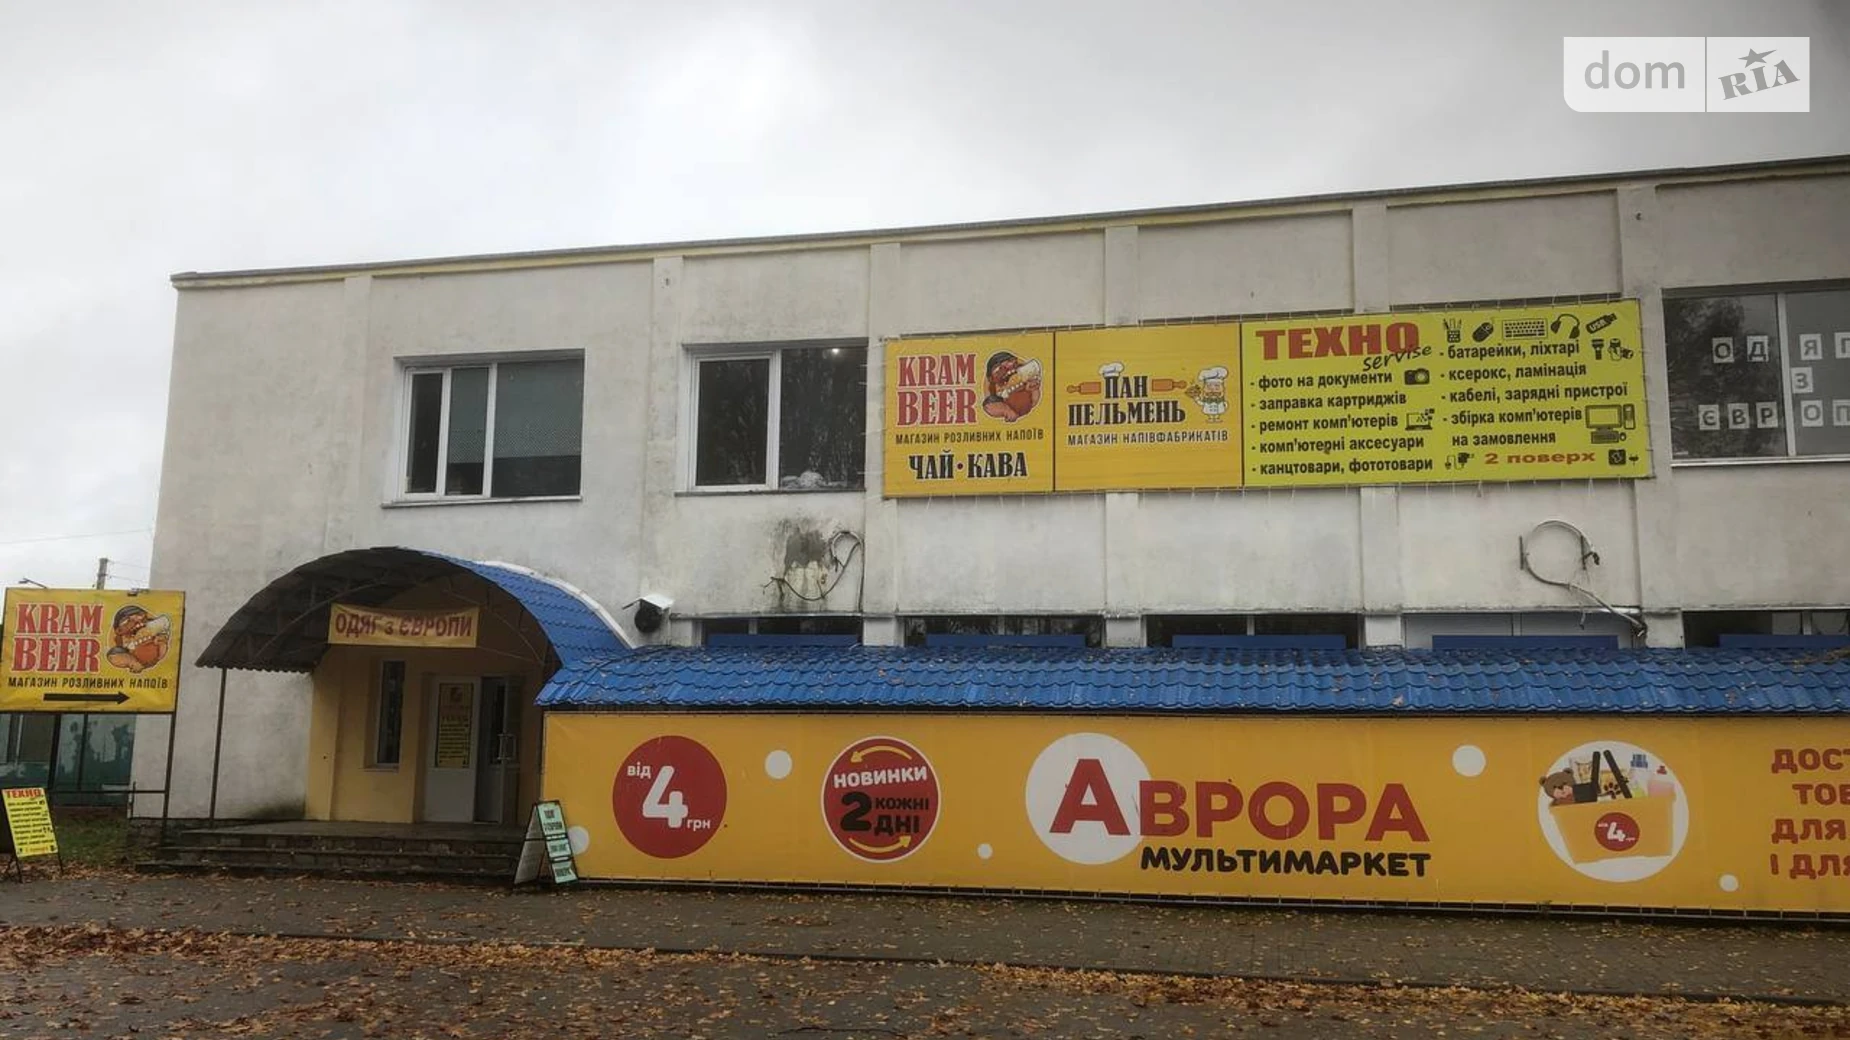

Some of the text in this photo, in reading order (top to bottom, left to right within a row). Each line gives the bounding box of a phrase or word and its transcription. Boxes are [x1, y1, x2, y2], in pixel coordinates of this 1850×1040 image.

[1256, 322, 1419, 360] ТЕХНО
[1448, 340, 1579, 361] батарейки, ліхтарі
[1363, 345, 1432, 372] servise
[897, 354, 976, 386] KRAM
[1449, 362, 1587, 382] ксерокс, ламінація
[1104, 376, 1148, 400] ПАН
[1258, 372, 1392, 392] фото на документи
[1450, 382, 1628, 404] кабелі, зарядні пристрої
[897, 387, 977, 427] BEER
[1259, 391, 1407, 412] заправка картриджів
[1068, 401, 1186, 427] ПЕЛЬМЕНЬ
[1259, 413, 1398, 434] ремонт комп'ютерів
[1451, 407, 1582, 426] збірка комп'ютерів
[896, 427, 1044, 445] МАГАЗИН РОЗЛИВНИХ НАПОЇВ
[1068, 430, 1228, 446] МАГАЗИН НАПІВФАБРИКАТІВ
[1349, 437, 1424, 452] аксесуари
[1452, 432, 1556, 446] на замовлення
[909, 449, 1028, 480] ЧАЙ КАВА
[1260, 458, 1433, 476] канцтовари, фототовари
[1484, 452, 1596, 465] 2 поверх
[15, 602, 104, 635] KRAM
[335, 612, 377, 638] ОДЯГ
[399, 616, 472, 638] ЄВРОПИ
[12, 636, 101, 673] BEER
[8, 676, 168, 689] МАГАЗИН РОЗЛИВНИХ НАПОЇВ
[833, 766, 927, 789] НОВИНКИ
[627, 761, 711, 834] від 4 грн
[1049, 758, 1430, 842] АВРОРА
[840, 791, 929, 832] 2 КОЖНІ
[874, 815, 920, 836] ДНІ
[1607, 821, 1626, 841] 4
[1771, 818, 1847, 844] ДЛЯ
[1141, 846, 1431, 877] МУЛЬТИМАРКЕТ
